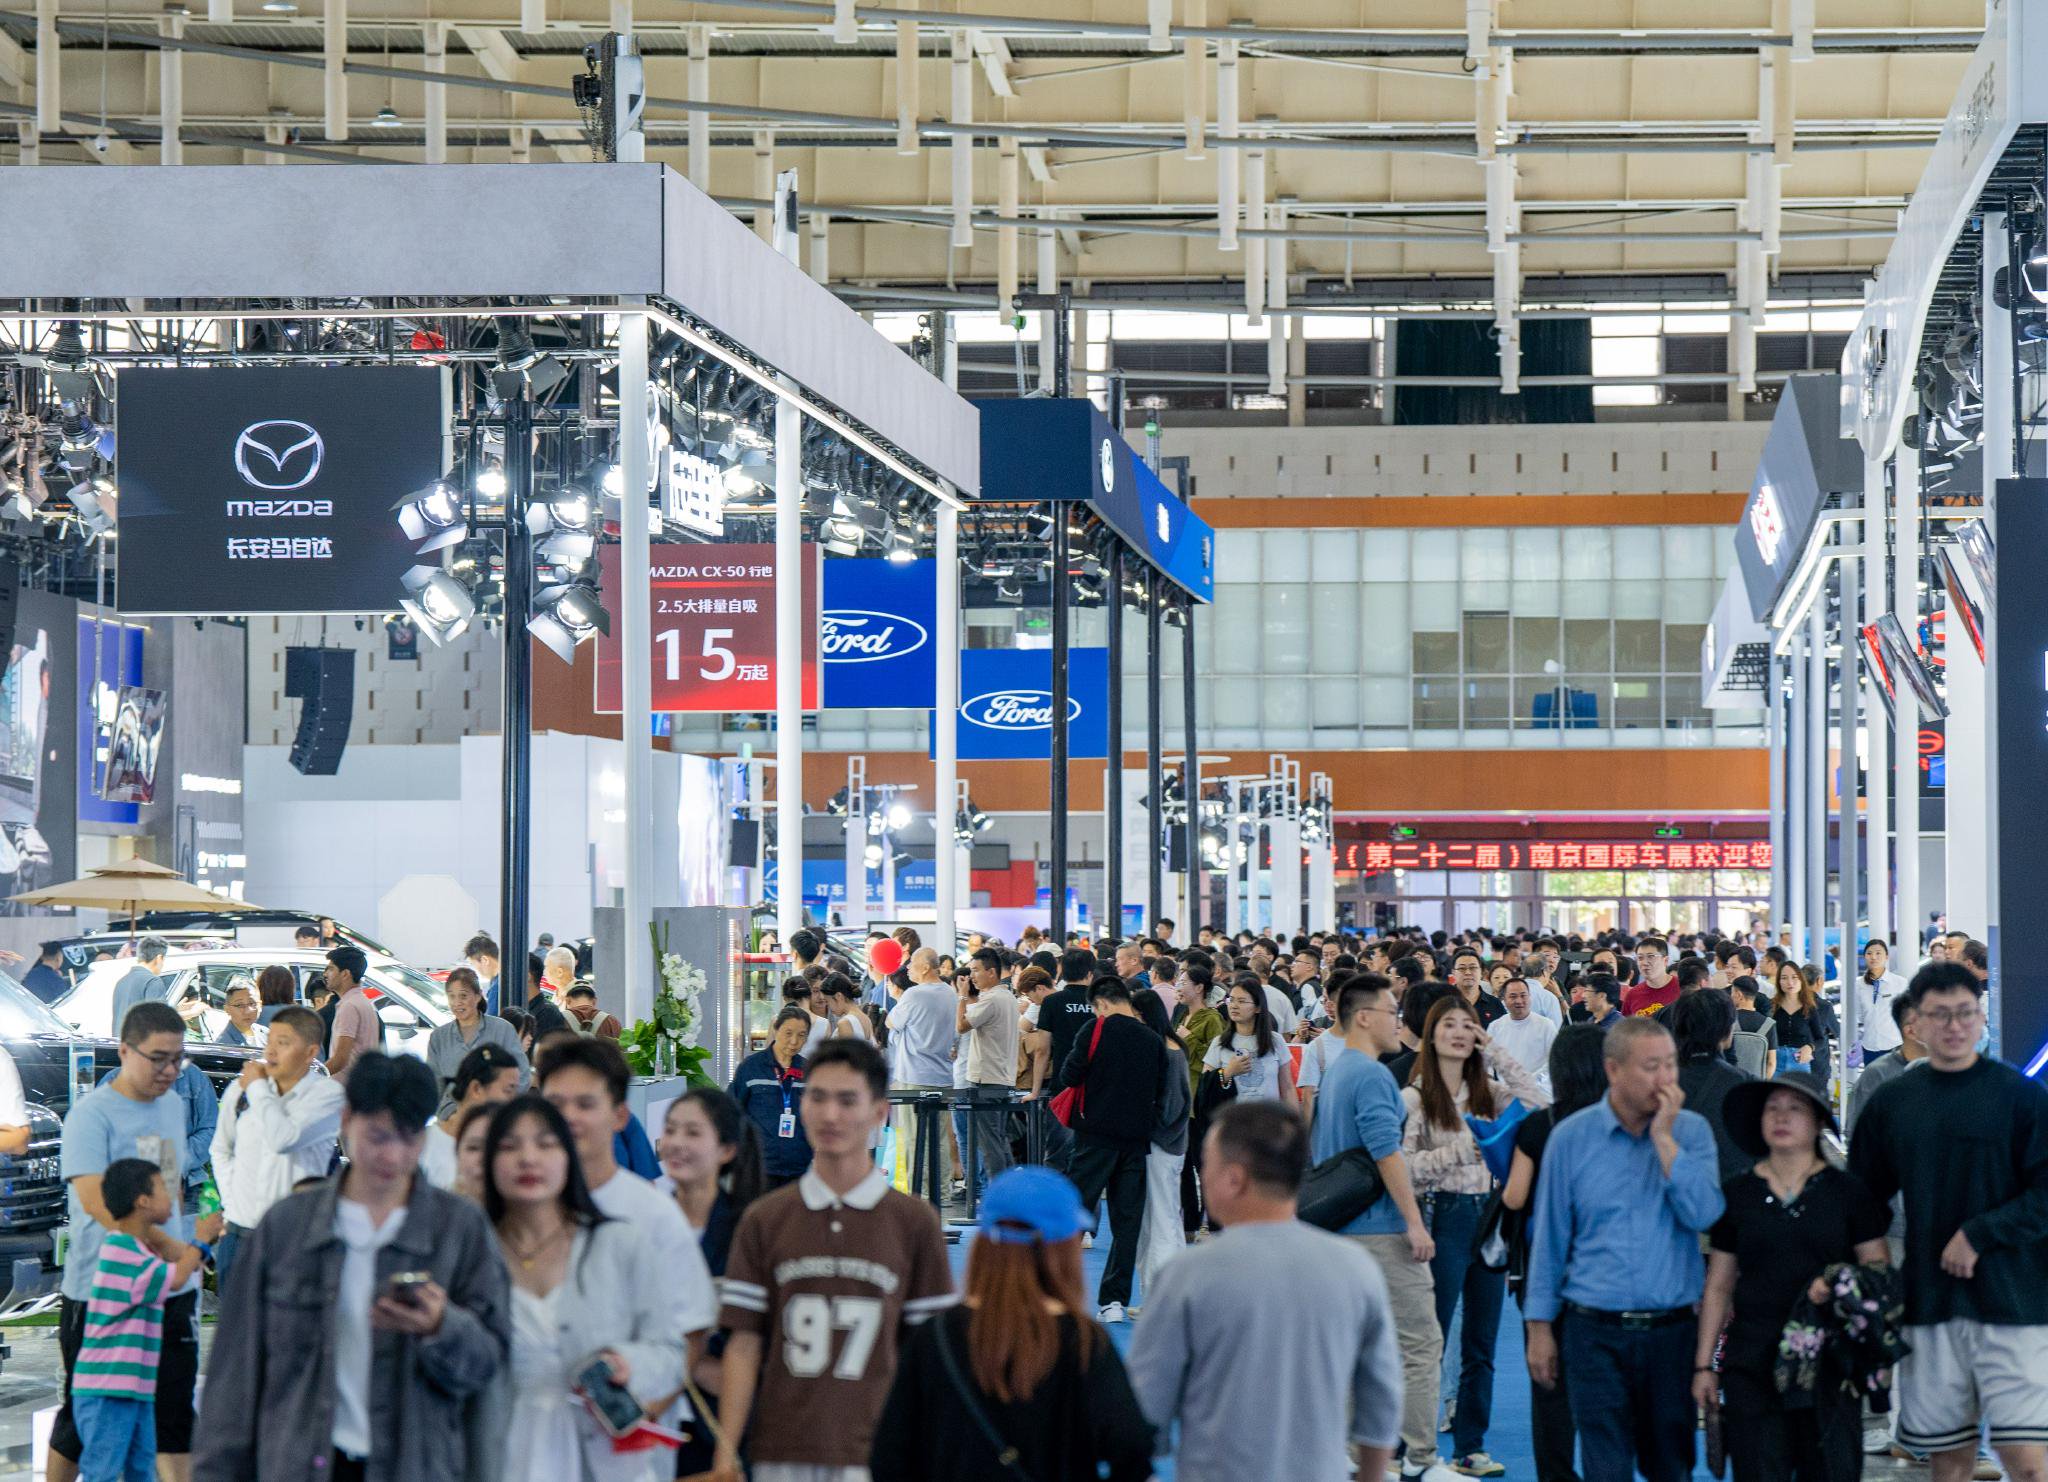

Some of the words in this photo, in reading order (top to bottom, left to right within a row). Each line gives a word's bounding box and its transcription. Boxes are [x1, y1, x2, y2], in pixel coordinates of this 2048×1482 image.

[227, 537, 333, 559] 长安马自达
[702, 566, 746, 578] CX-50
[748, 565, 773, 578] 行也
[657, 599, 758, 614] 2.5大排量自吸
[782, 1293, 883, 1381] 97
